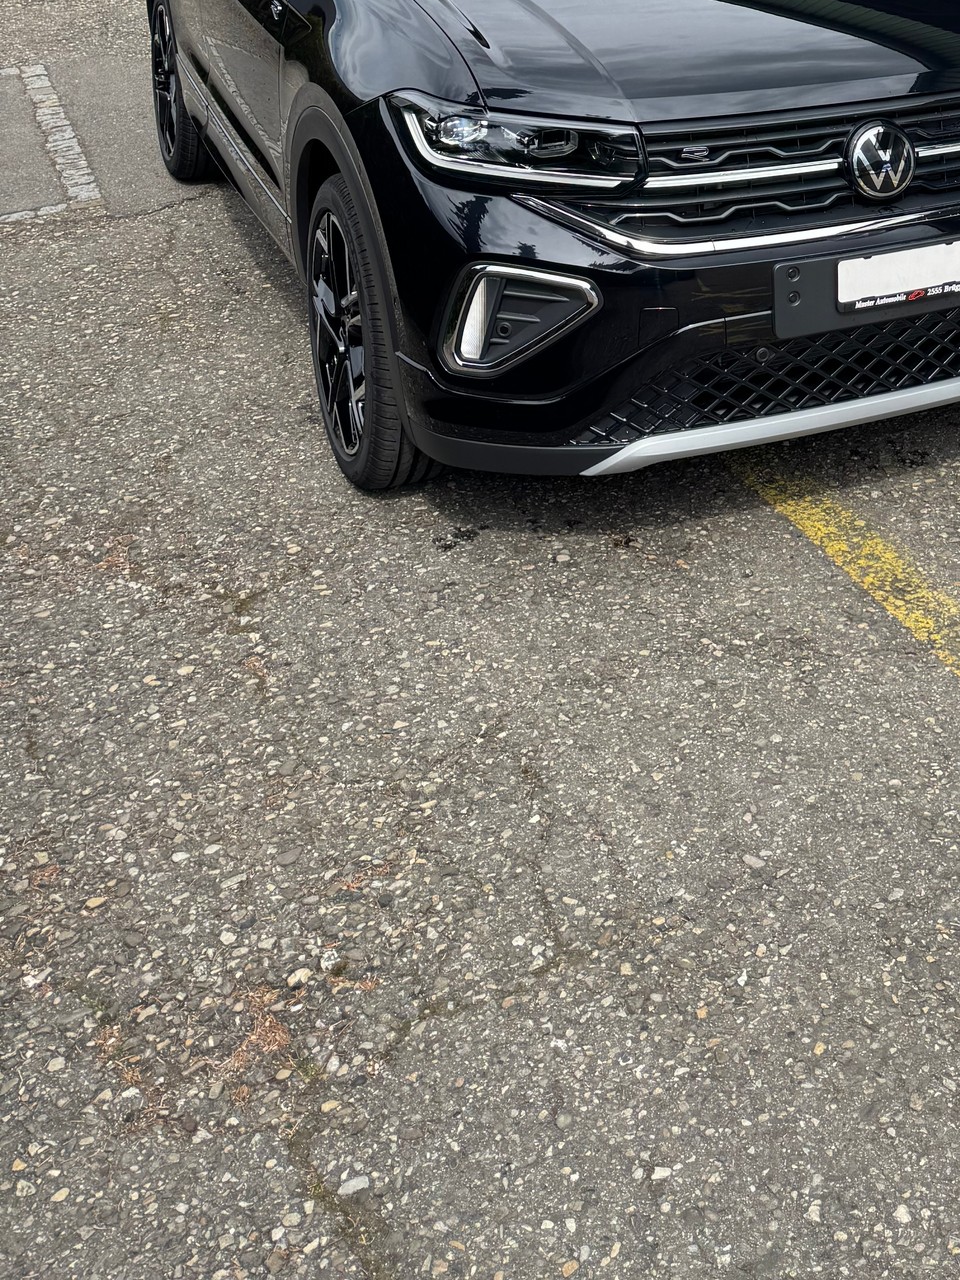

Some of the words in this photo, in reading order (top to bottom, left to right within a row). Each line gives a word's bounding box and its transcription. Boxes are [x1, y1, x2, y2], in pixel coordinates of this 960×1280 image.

[855, 300, 875, 309] Muster
[875, 293, 907, 306] Automobile
[927, 286, 943, 296] 2555
